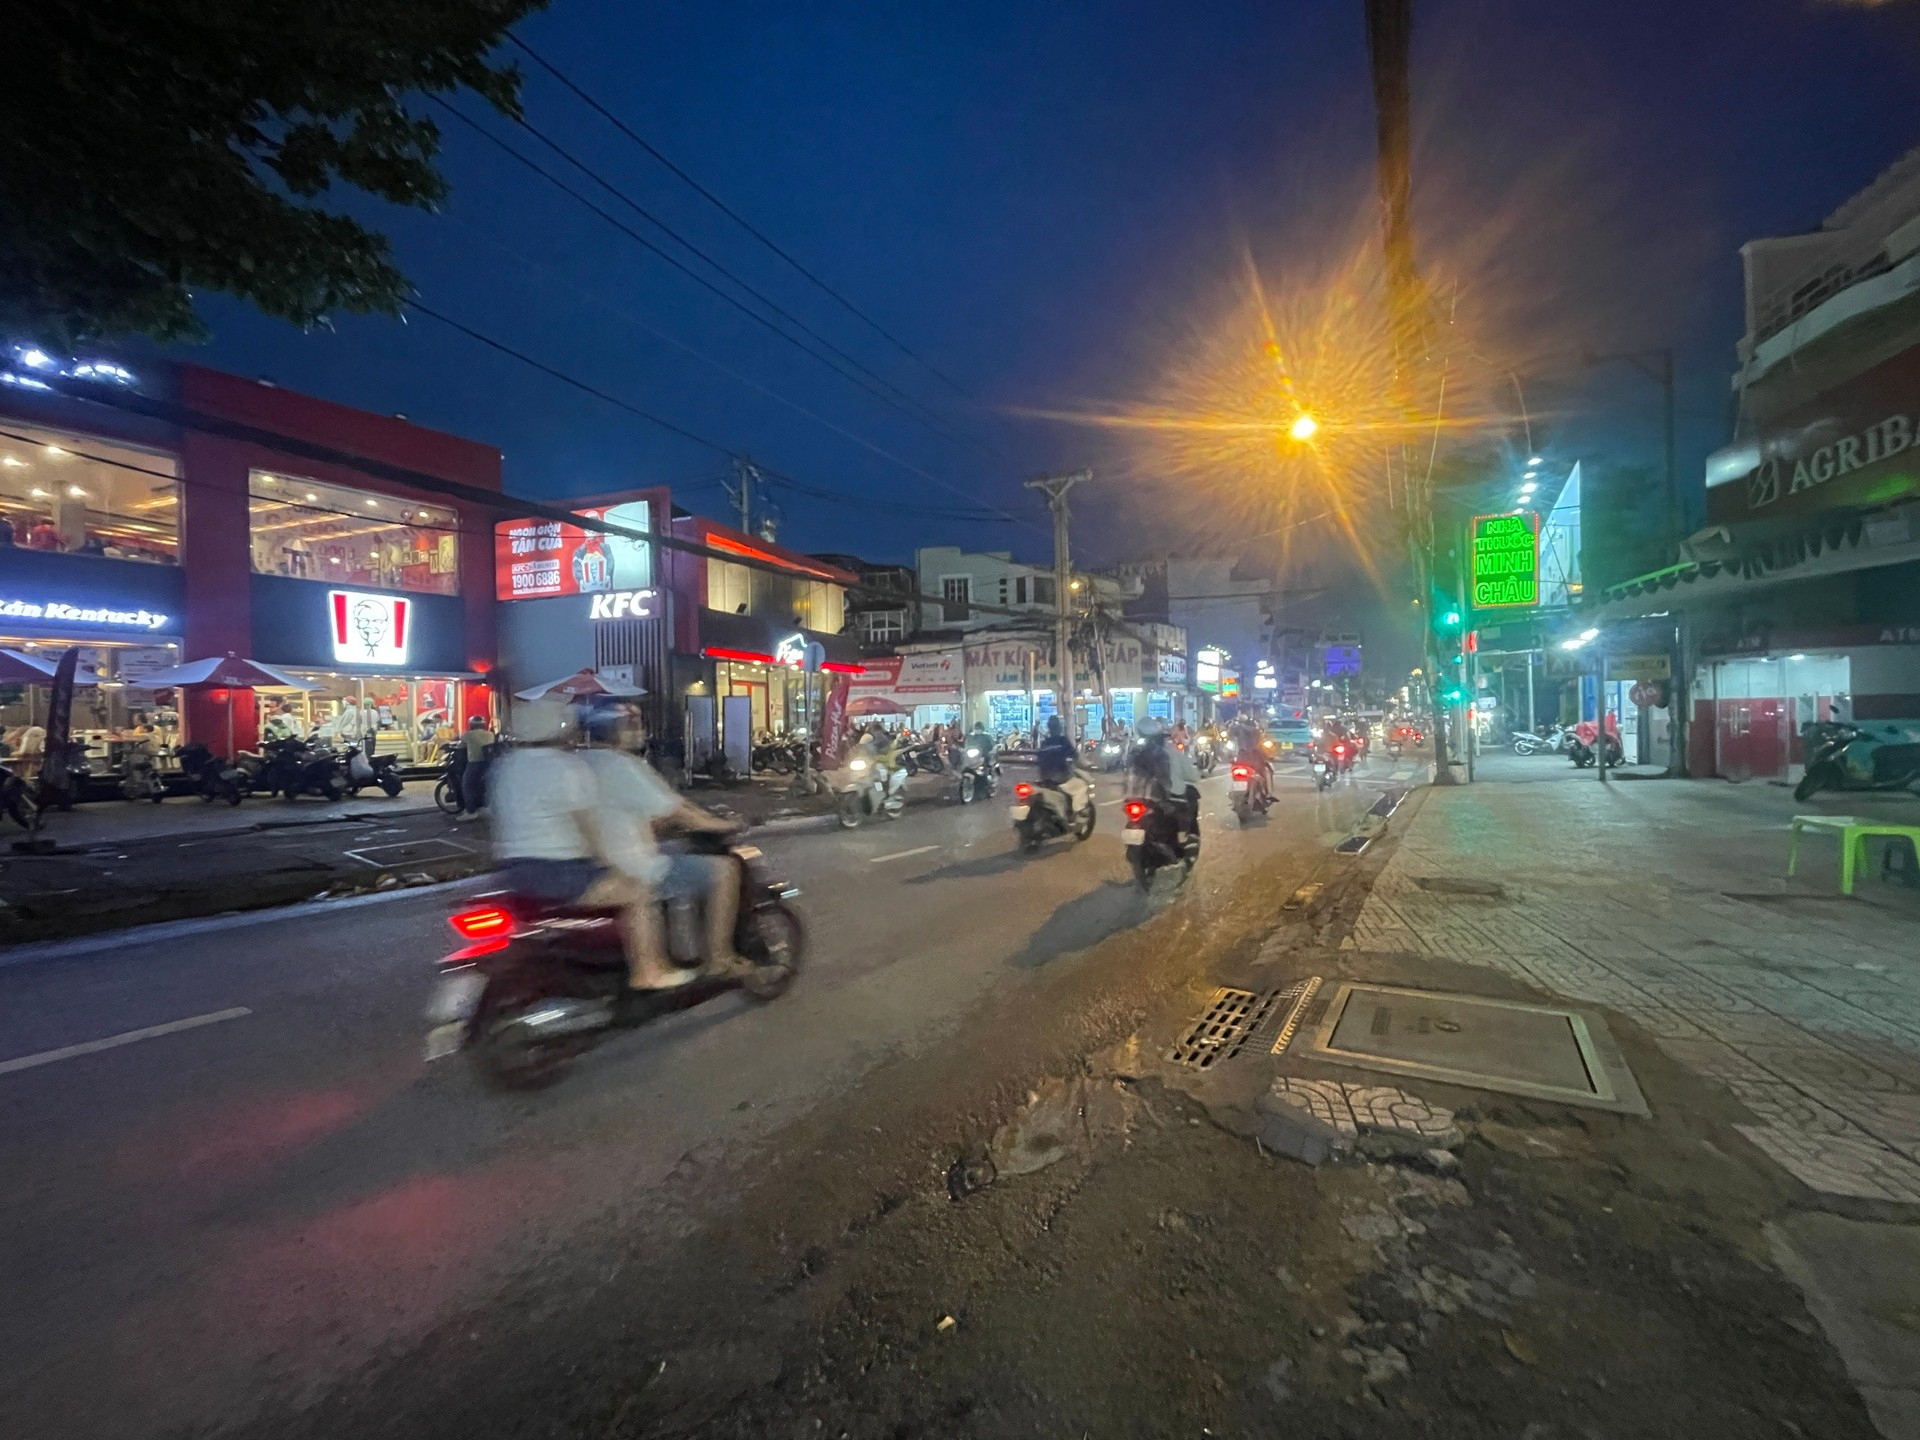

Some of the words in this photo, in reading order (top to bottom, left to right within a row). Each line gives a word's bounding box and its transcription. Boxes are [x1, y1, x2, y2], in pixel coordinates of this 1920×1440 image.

[1486, 516, 1523, 534] NHÀ
[1475, 530, 1534, 551] THUỐC
[1477, 550, 1533, 575] MINH
[512, 573, 534, 588] 1900
[536, 570, 560, 586] 6886
[1476, 576, 1534, 604] CHÂU
[0, 600, 42, 618] án
[45, 602, 168, 629] Kentucky
[590, 590, 654, 619] KFC
